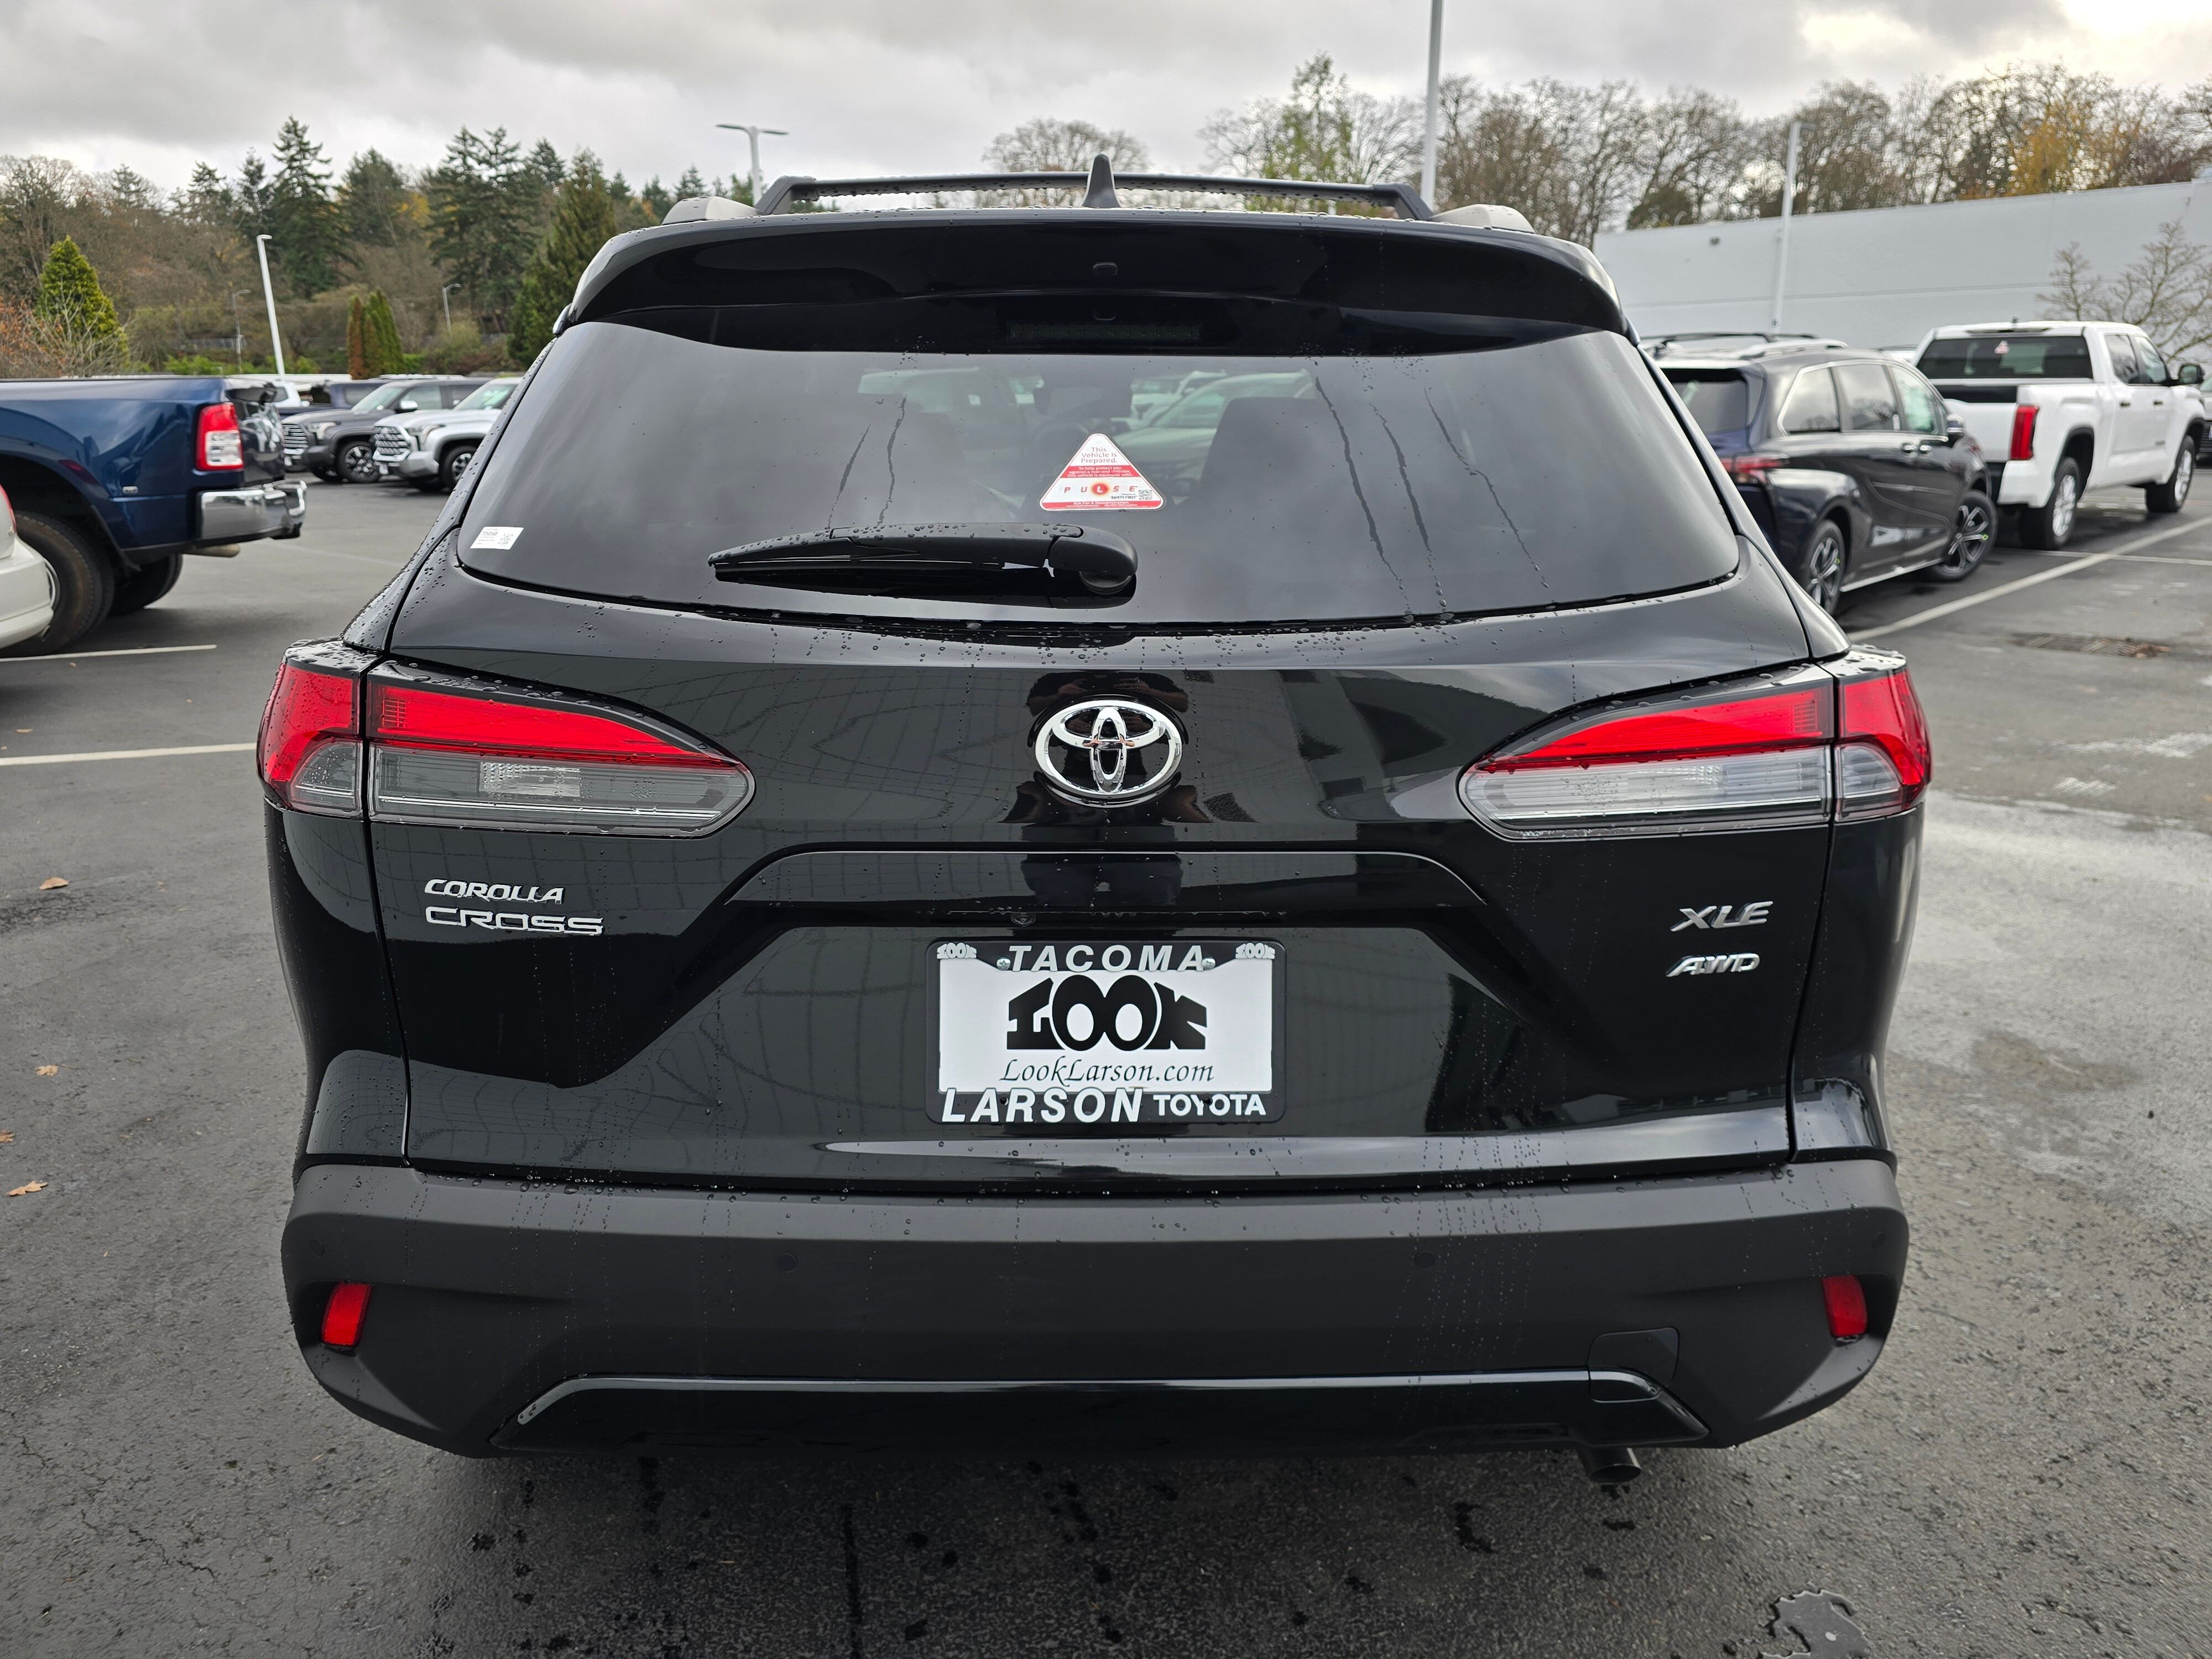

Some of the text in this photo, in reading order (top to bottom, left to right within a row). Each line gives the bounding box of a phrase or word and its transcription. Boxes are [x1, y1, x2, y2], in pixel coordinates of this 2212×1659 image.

[424, 878, 565, 904] COROLLA
[425, 906, 604, 936] CROSS
[1670, 901, 1773, 932] XLE
[1008, 944, 1204, 972] TACOMA
[1666, 953, 1760, 977] AWD
[1006, 974, 1208, 1051] LOOK
[999, 1055, 1214, 1087] LookLarson.com
[942, 1087, 1267, 1123] LARSON TOYOTA
